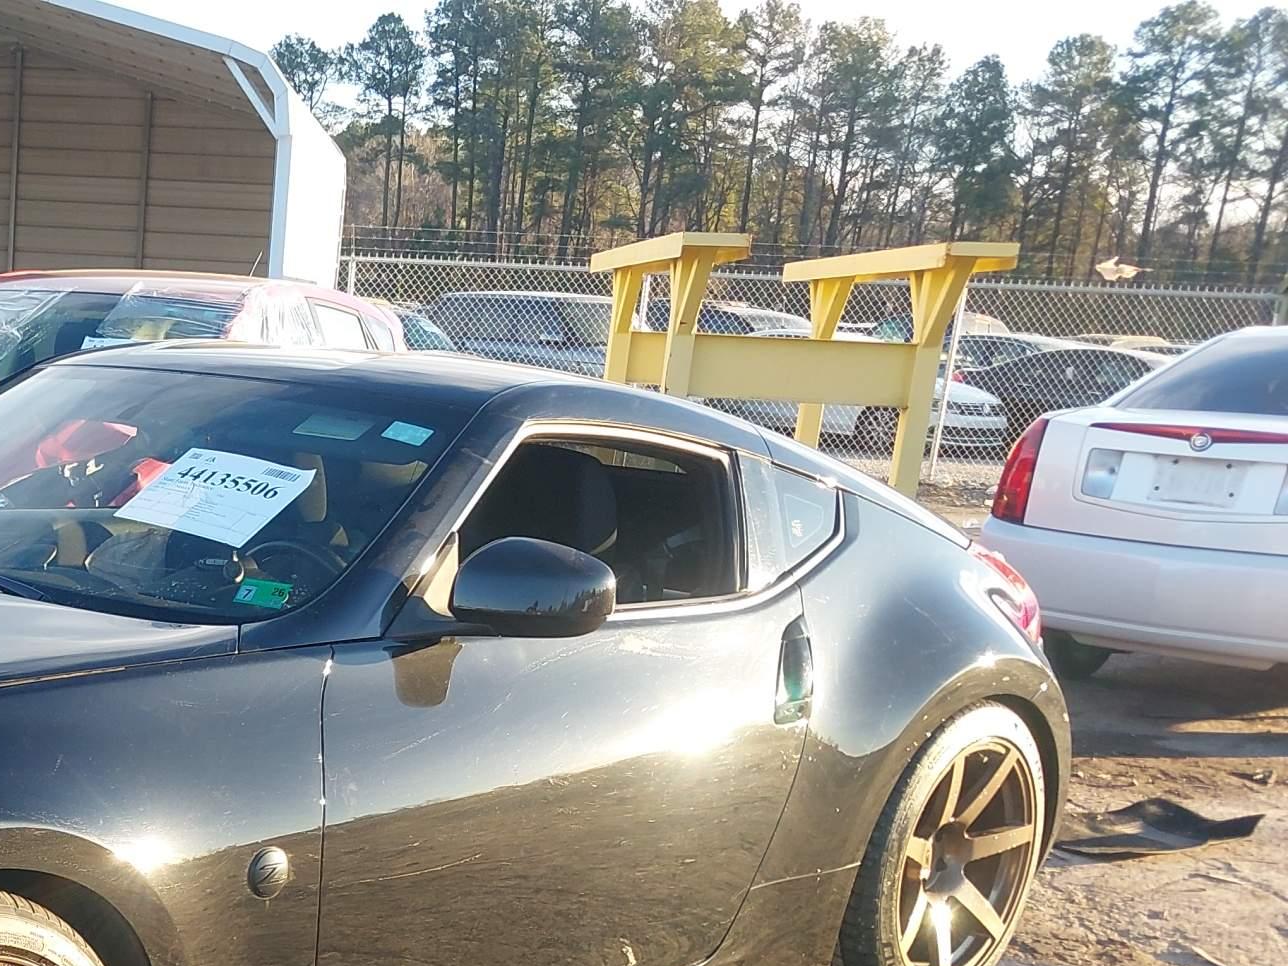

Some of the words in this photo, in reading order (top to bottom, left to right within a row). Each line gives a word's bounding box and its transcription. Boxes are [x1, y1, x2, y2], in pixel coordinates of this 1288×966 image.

[177, 466, 284, 500] 44135506
[242, 588, 253, 599] 7
[272, 587, 286, 598] 26
